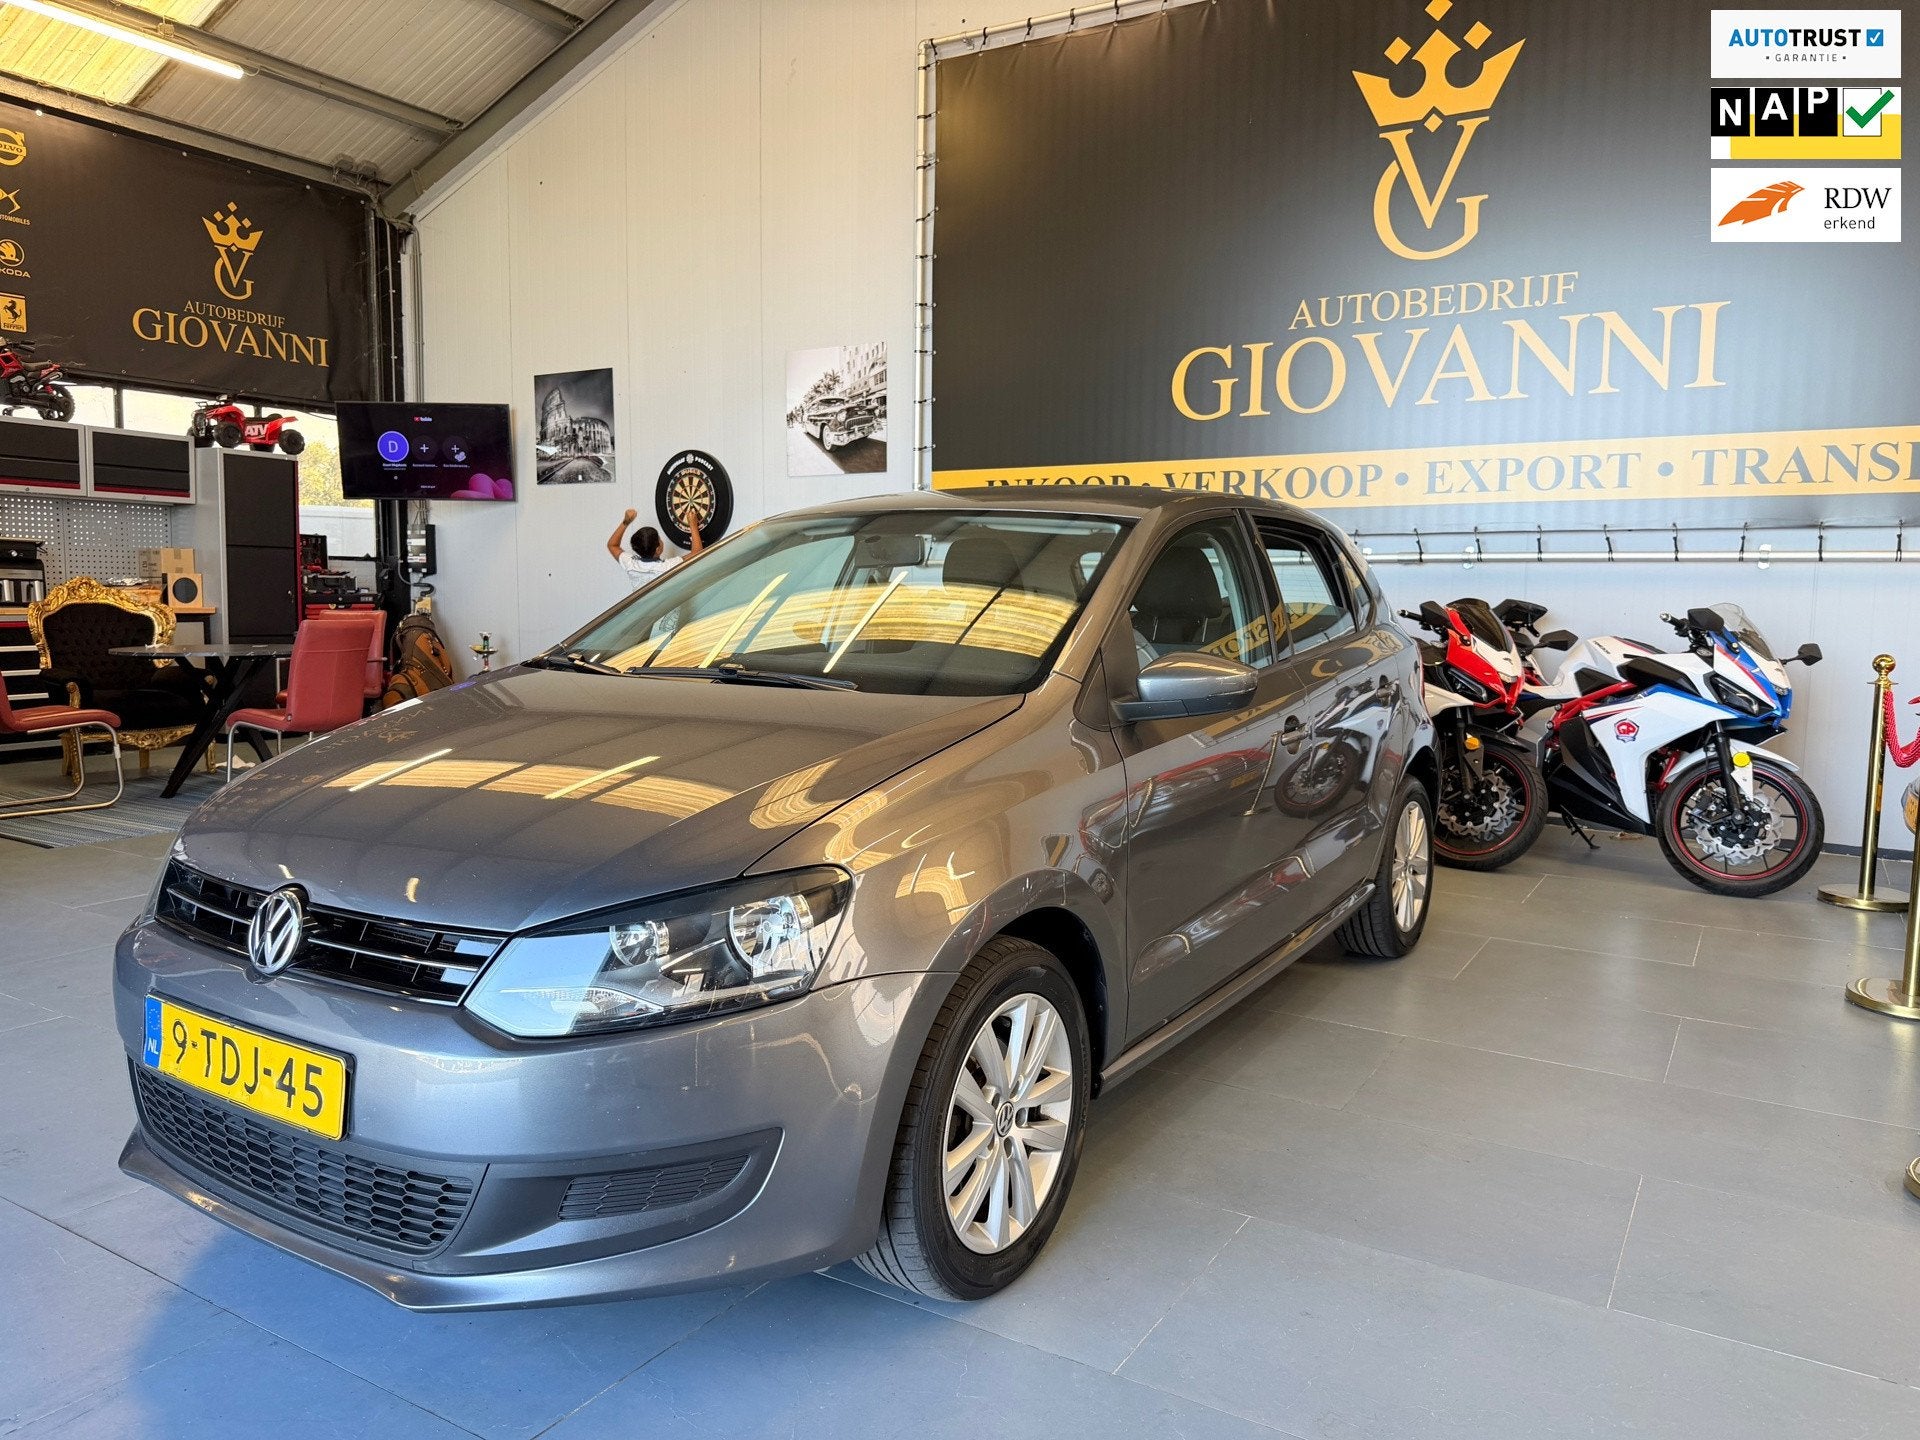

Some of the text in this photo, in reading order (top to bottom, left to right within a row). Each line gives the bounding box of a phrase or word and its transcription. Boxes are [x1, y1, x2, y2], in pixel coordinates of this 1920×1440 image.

[183, 300, 286, 329] AUTOBEDRIJF
[1288, 271, 1579, 330] AUTOBEDRIJF
[132, 307, 330, 368] GIOVANNI
[1171, 300, 1732, 421] GIOVANNI
[244, 424, 269, 437] ATV
[1424, 451, 1642, 495] EXPORT
[147, 1037, 160, 1056] NL
[172, 1020, 323, 1118] 9-TDJ-45
